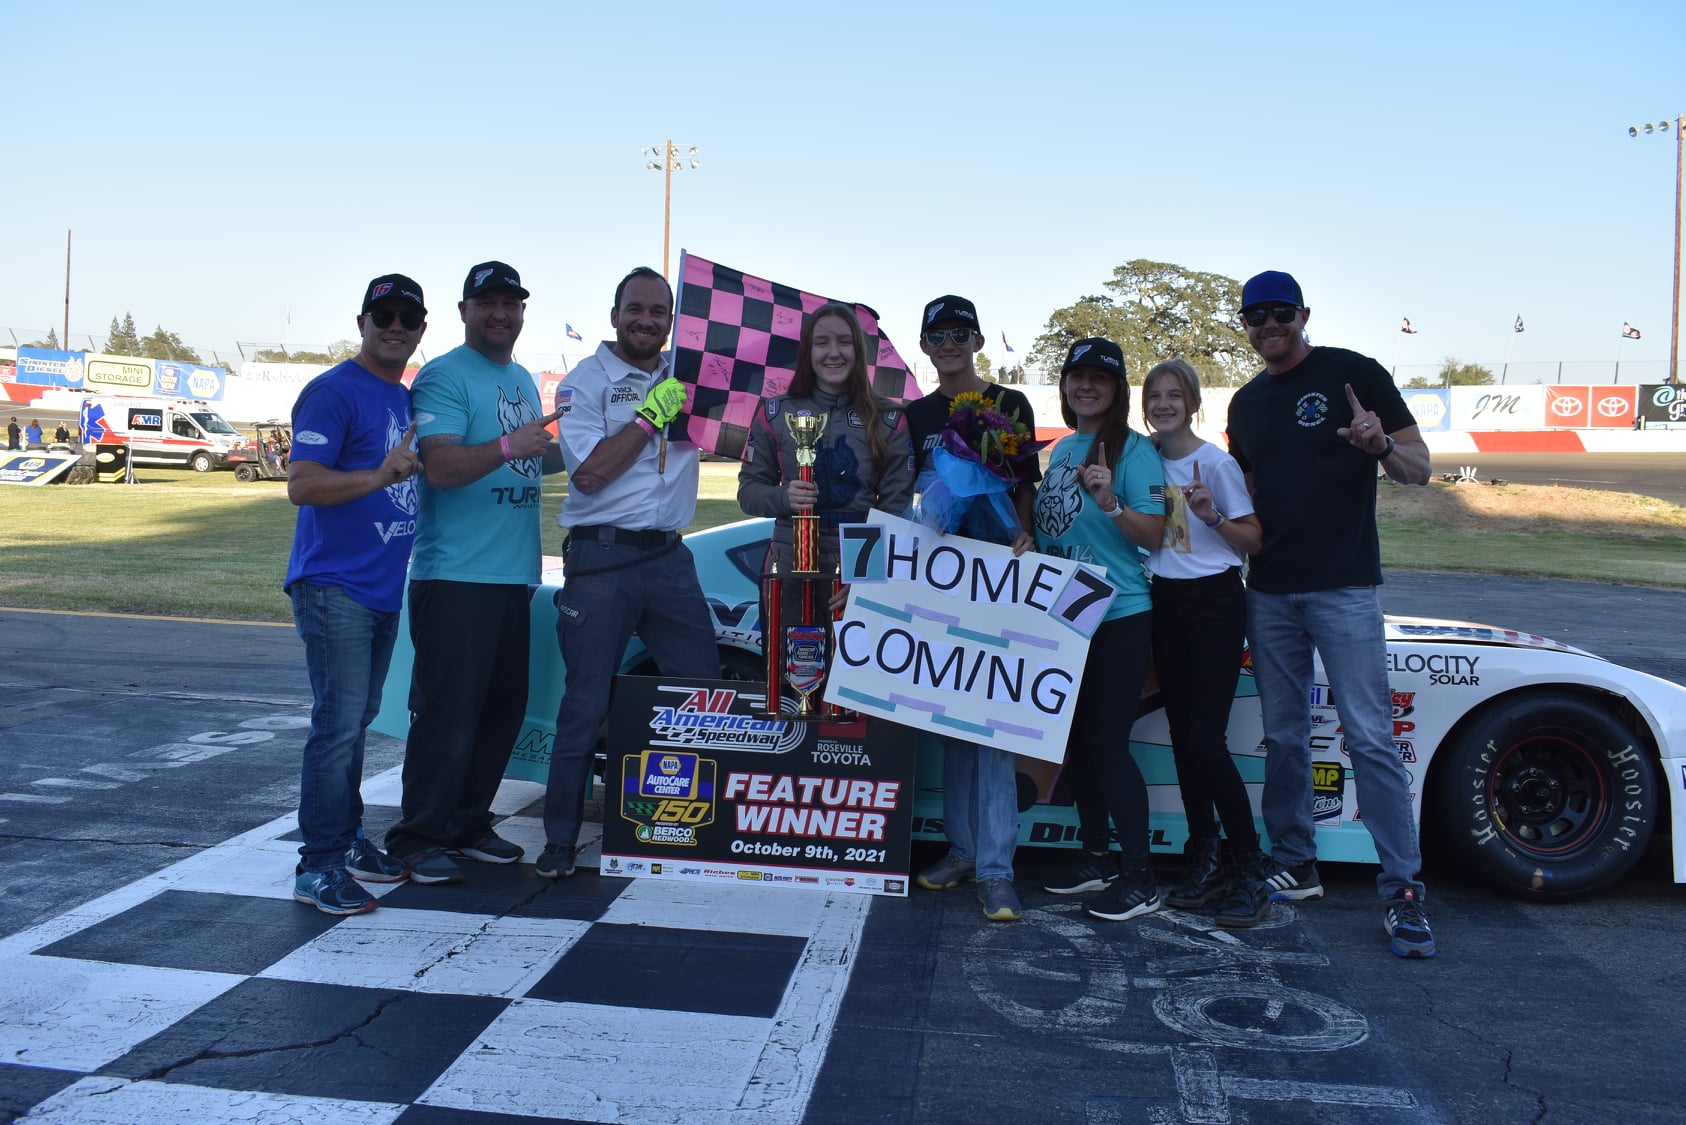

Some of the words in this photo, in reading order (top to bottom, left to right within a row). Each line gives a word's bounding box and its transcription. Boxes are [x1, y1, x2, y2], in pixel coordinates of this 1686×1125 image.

[19, 358, 66, 368] SINISTER
[26, 365, 63, 374] DIESEL
[122, 366, 143, 375] MINI
[95, 373, 143, 384] STORAGE
[193, 377, 215, 391] NAPA
[610, 393, 641, 404] OFFICIAL
[1412, 403, 1439, 417] NAPA
[131, 414, 162, 426] AMR
[843, 527, 881, 578] 7
[887, 534, 1062, 612] HOME
[1061, 568, 1115, 623] 7
[838, 620, 1074, 715] COMING
[1429, 674, 1480, 687] SOLAR
[680, 690, 736, 714] All
[652, 708, 788, 732] American
[697, 728, 780, 752] Speedway
[817, 743, 863, 754] ROSEVILLE
[663, 760, 679, 770] NAPA
[811, 751, 872, 767] TOYOTA
[654, 786, 680, 795] CENTER
[724, 772, 900, 809] FEATURE
[651, 800, 711, 823] 150
[736, 804, 886, 840] WINNER
[653, 826, 693, 837] BERCO
[652, 835, 690, 843] REDWOOD
[730, 840, 801, 857] October
[804, 844, 838, 862] 9th,
[844, 848, 886, 863] 2021
